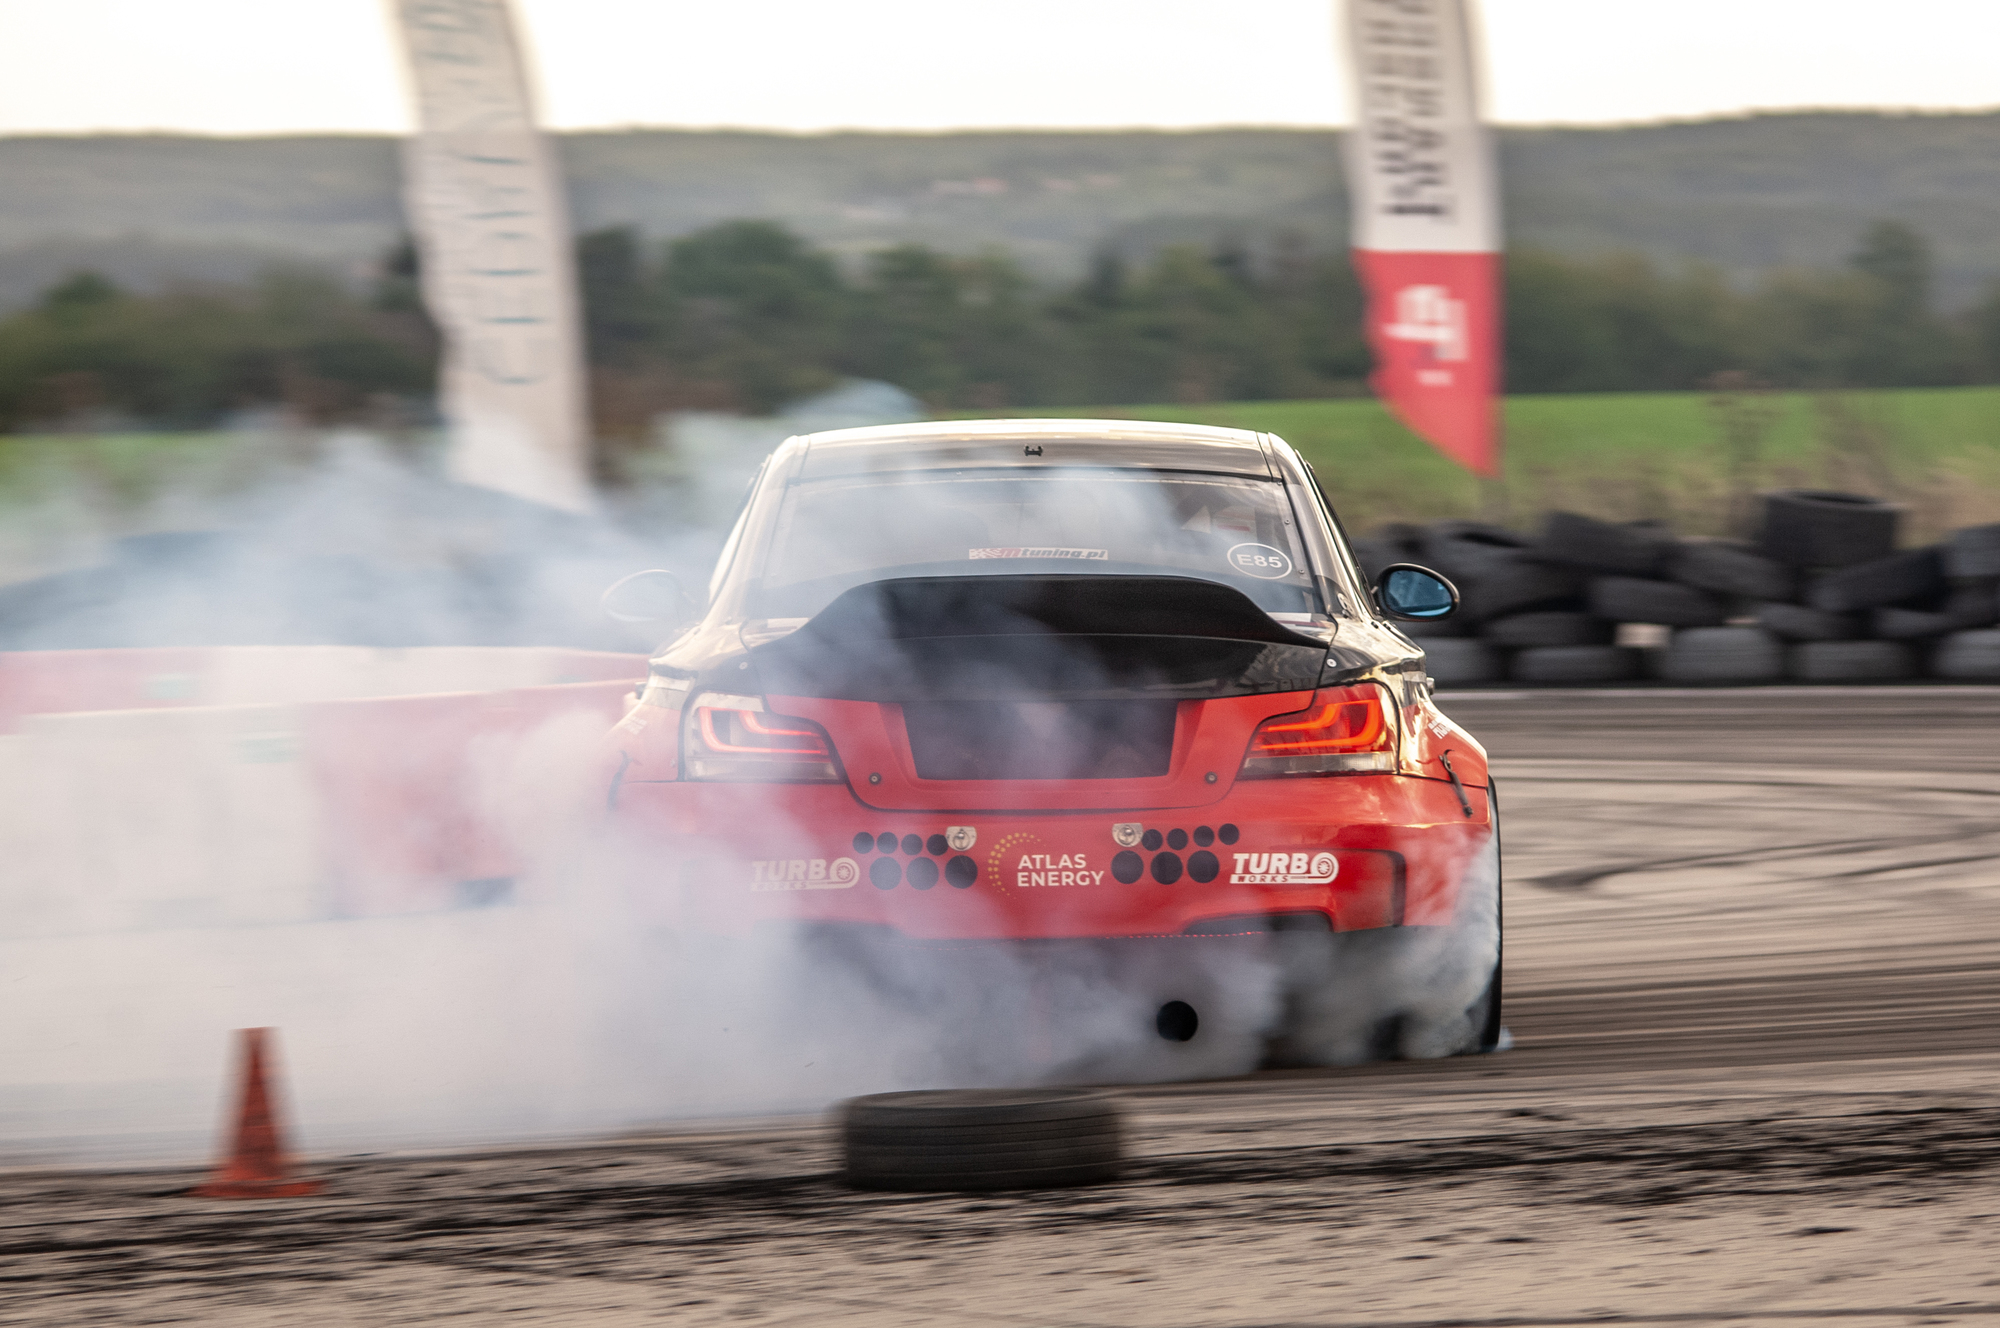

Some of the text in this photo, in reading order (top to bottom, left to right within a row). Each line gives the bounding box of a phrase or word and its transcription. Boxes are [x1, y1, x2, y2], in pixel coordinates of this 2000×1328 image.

[1236, 554, 1283, 569] E85
[1017, 853, 1087, 870] ATLAS
[1017, 870, 1105, 887] ENERGY
[1236, 875, 1289, 883] WORKS
